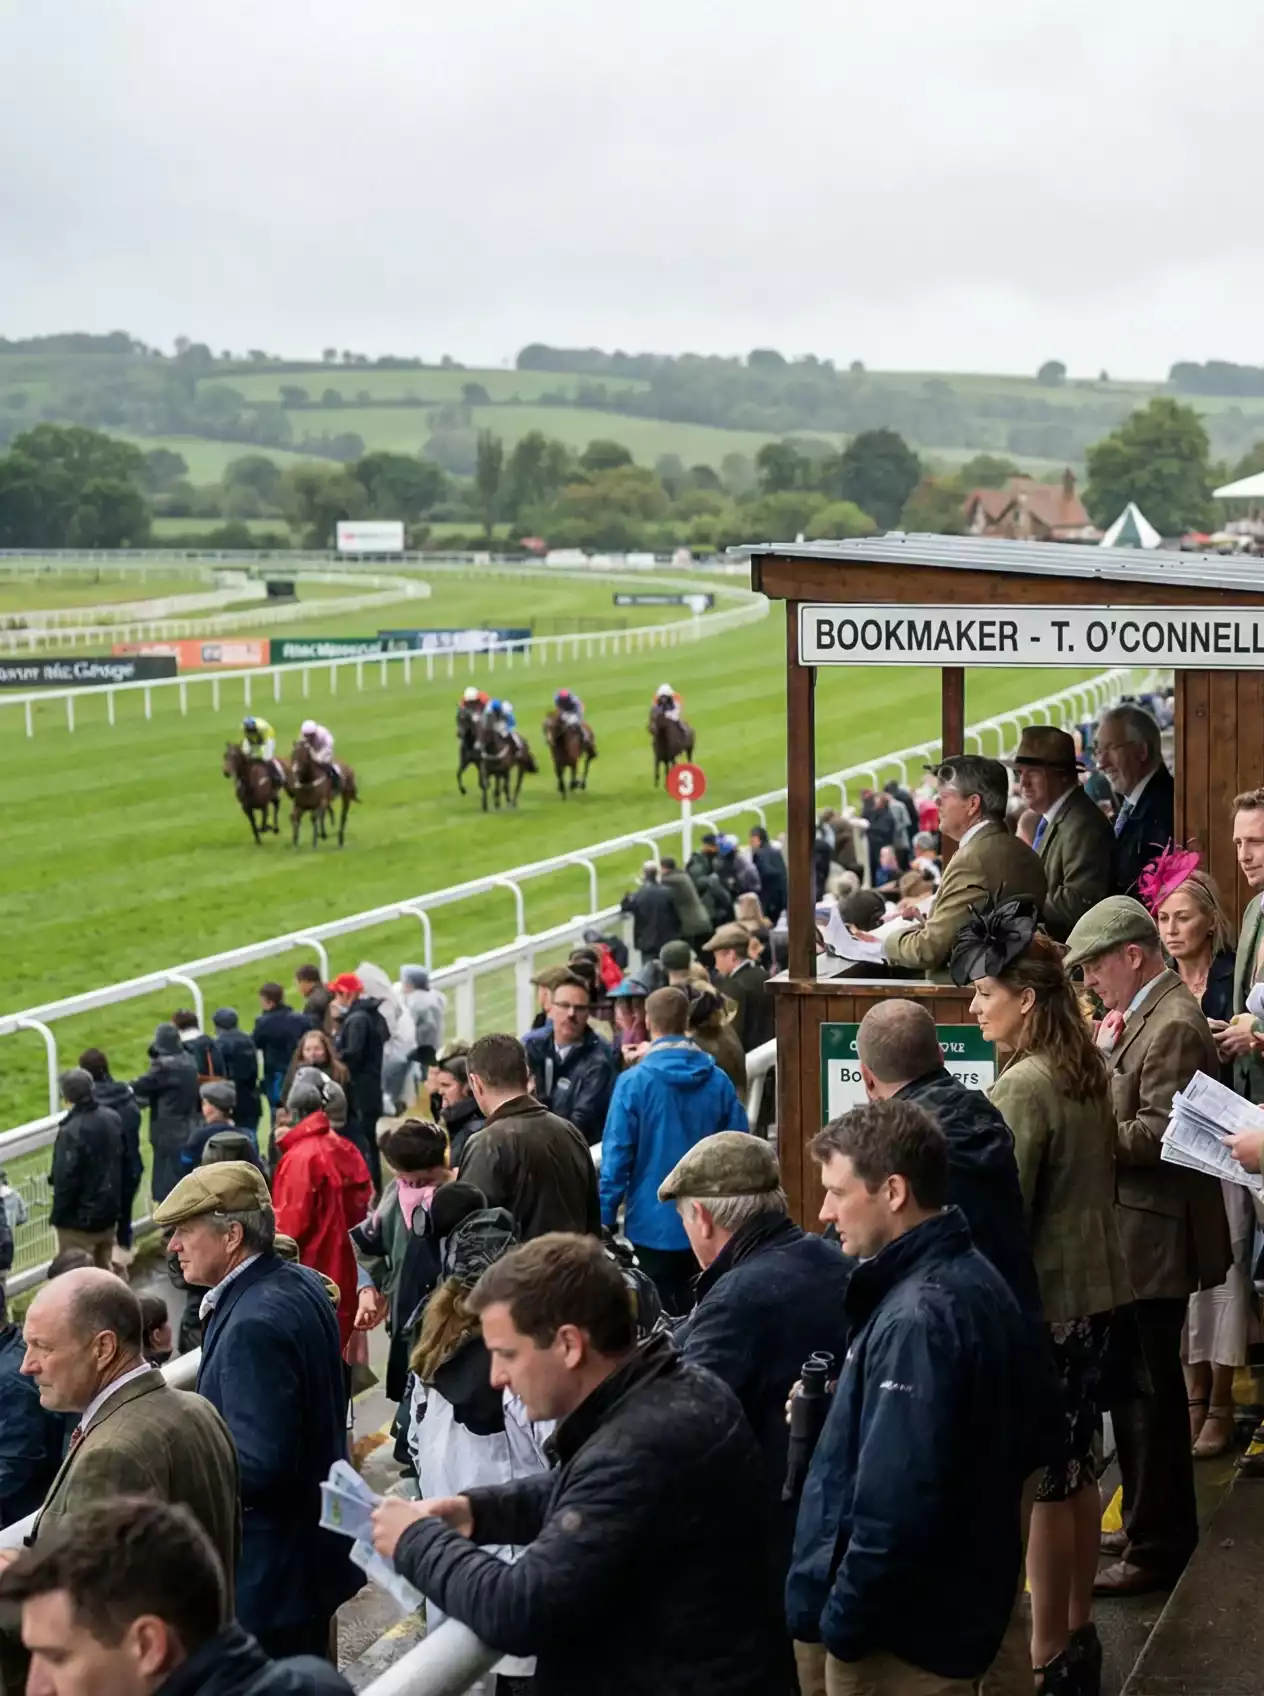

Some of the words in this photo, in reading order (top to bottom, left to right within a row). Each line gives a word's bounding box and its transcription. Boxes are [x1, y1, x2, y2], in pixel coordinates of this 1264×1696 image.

[816, 619, 1018, 652] BOOKMAKER
[1051, 620, 1074, 652] T.
[678, 770, 694, 797] 3
